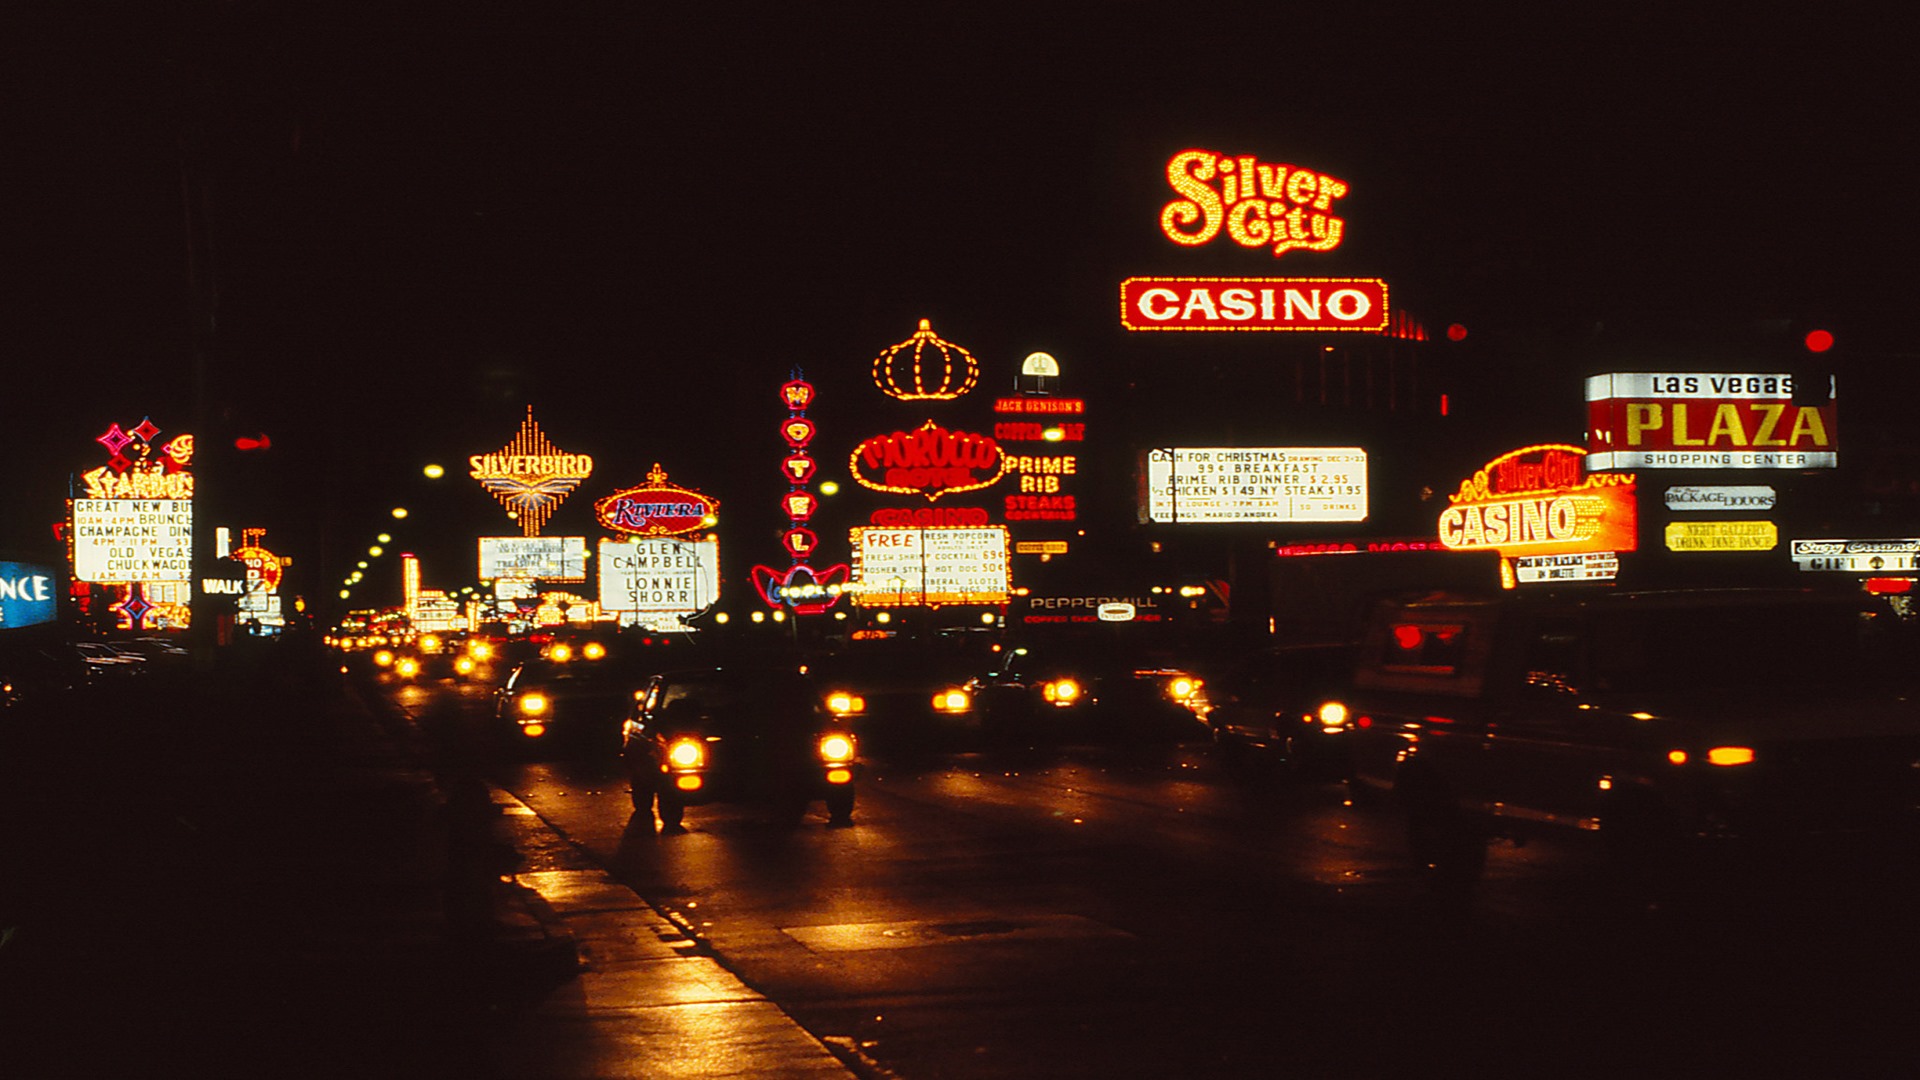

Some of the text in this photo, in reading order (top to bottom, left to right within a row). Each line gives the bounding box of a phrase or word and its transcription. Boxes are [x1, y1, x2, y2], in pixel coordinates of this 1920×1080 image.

[1161, 150, 1348, 244] Silver
[1228, 199, 1344, 255] City
[1137, 288, 1371, 320] CASINO
[995, 400, 1022, 413] JACK
[1626, 403, 1829, 446] PLAZA
[1188, 453, 1210, 462] FOR
[1217, 453, 1286, 462] CHRISTMAS
[1645, 455, 1806, 464] SHOPPING CENTER
[470, 455, 593, 475] SILVERBIRD
[785, 386, 810, 552] MOTEL
[1006, 457, 1076, 474] PRIME
[1235, 464, 1318, 473] BREAKFAST
[1021, 476, 1060, 493] RIB
[1168, 475, 1207, 485] PRIME
[1219, 475, 1240, 484] RIB
[1250, 475, 1300, 484] DINNER
[1166, 486, 1217, 495] CHICKEN
[1261, 486, 1277, 495] NY
[1285, 486, 1323, 495] STEAK
[1666, 492, 1723, 502] PACKAGE
[77, 502, 119, 512] GREAT
[133, 502, 161, 512] NEW
[1005, 497, 1075, 510] STEAKS
[613, 499, 705, 527] RIVIERA
[1439, 498, 1576, 547] CASINO
[80, 526, 158, 536] CHAMPAGNE
[867, 533, 914, 547] FREE
[110, 548, 134, 557] OLD
[637, 543, 681, 554] GLEN
[614, 557, 703, 568] CAMPBELL
[1811, 558, 1858, 569] GIFT
[203, 579, 244, 594] WALK
[626, 578, 691, 589] LONNIE
[629, 591, 688, 602] SHORR
